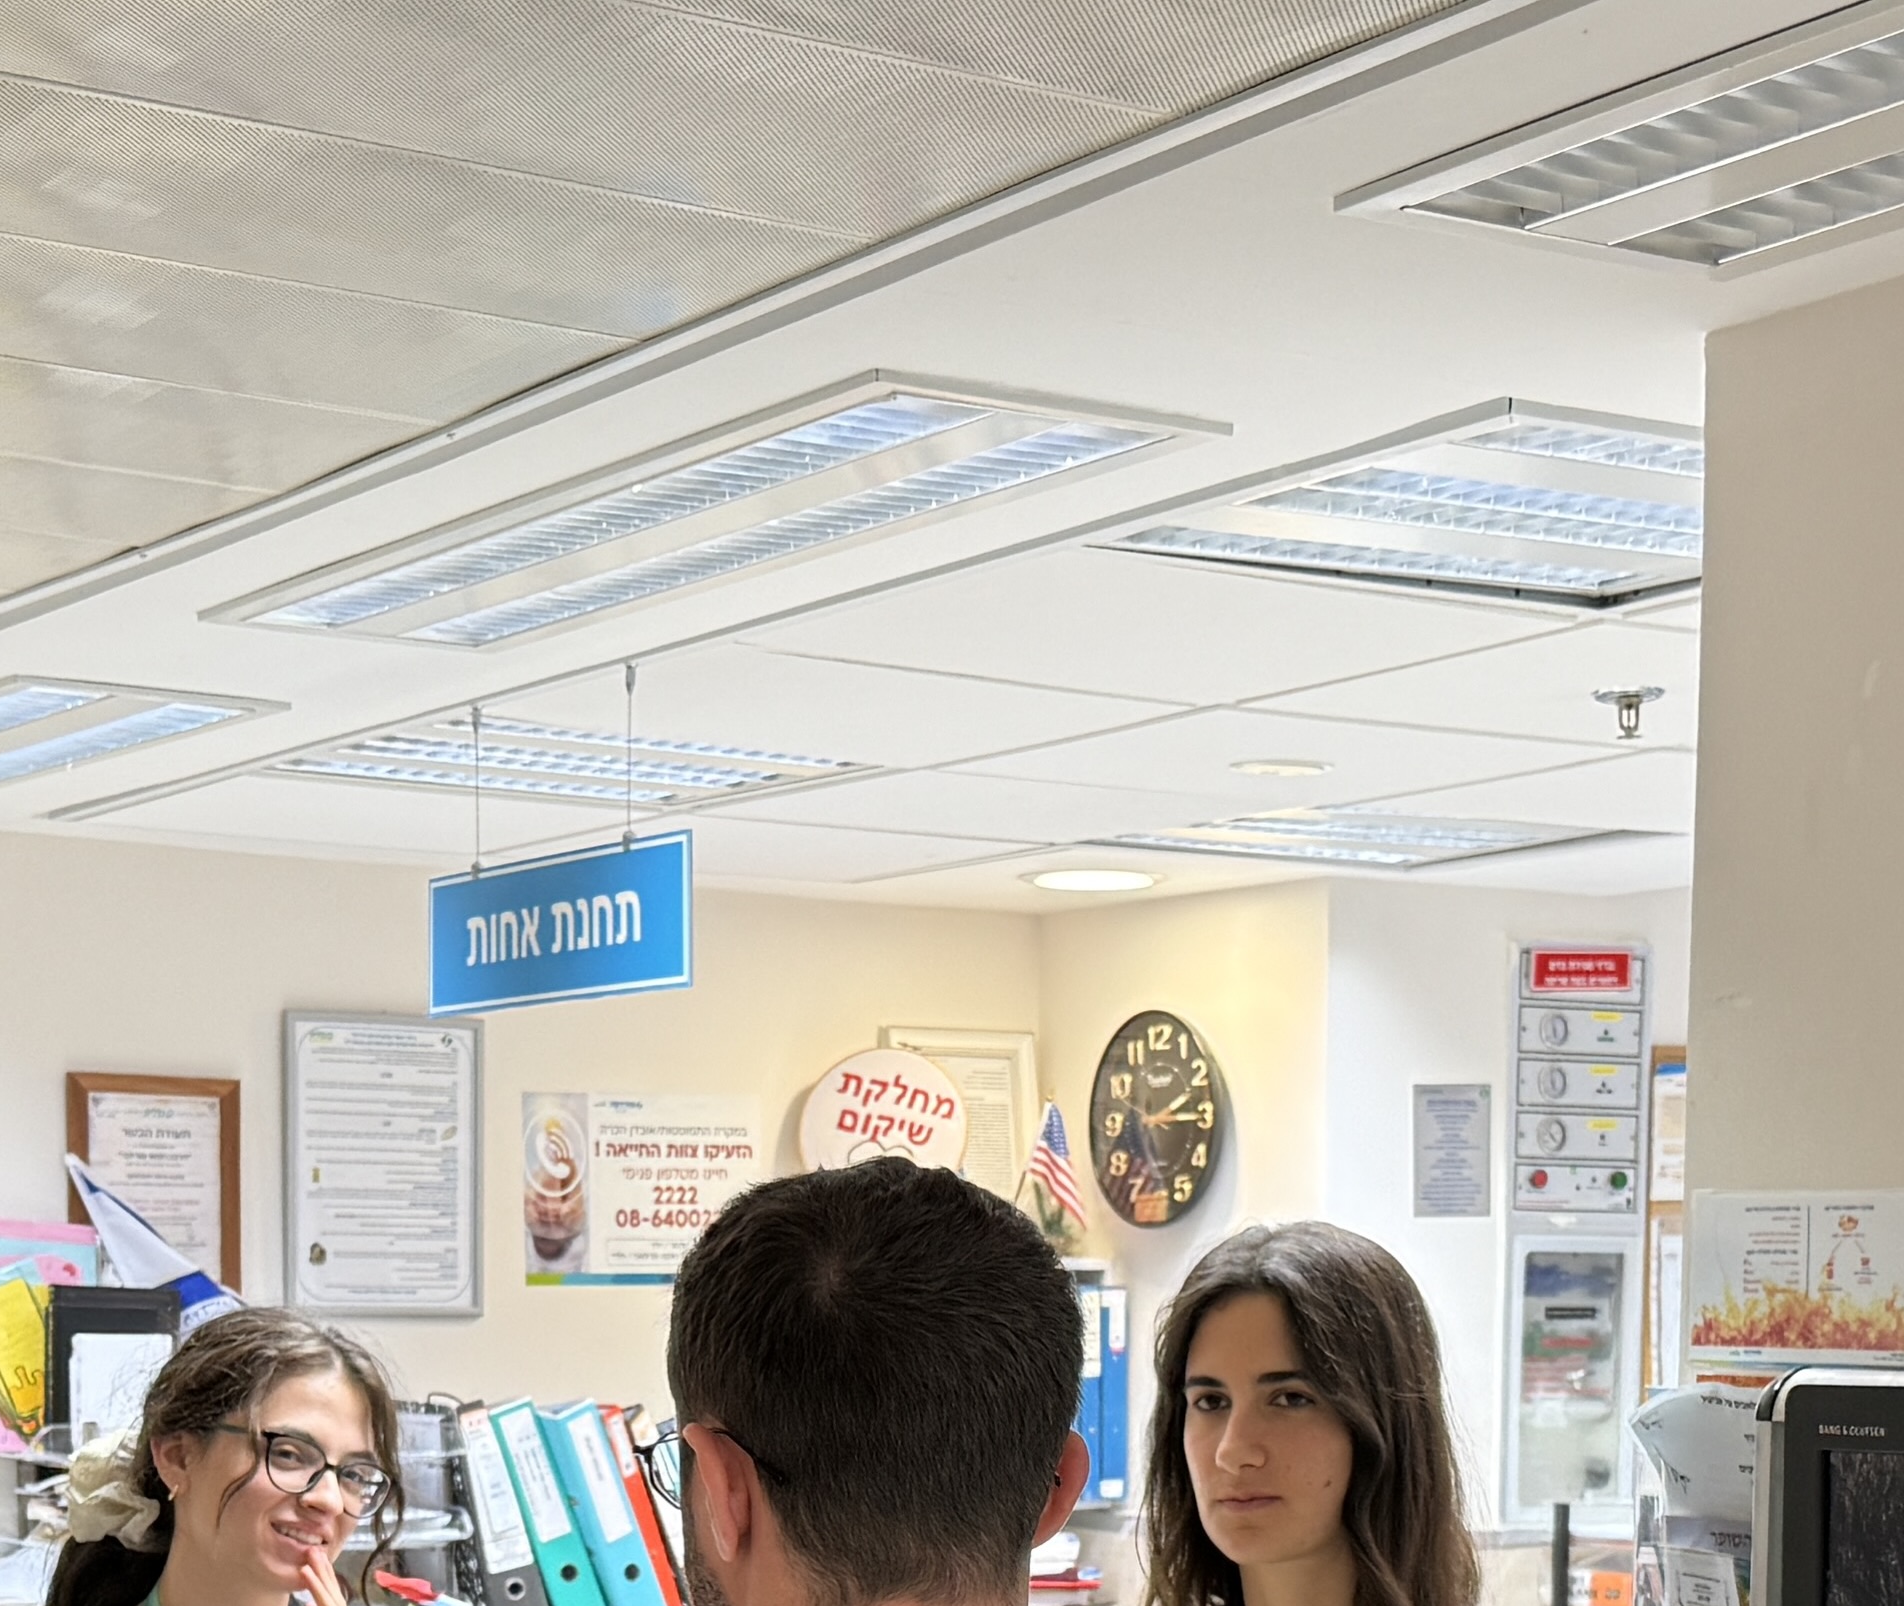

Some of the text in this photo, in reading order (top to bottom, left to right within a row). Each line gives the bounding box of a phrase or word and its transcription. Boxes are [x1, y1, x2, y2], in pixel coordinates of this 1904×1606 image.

[466, 890, 641, 967] תחנת אחות
[1147, 1023, 1174, 1051] 12
[1178, 1032, 1188, 1059] 1
[1127, 1039, 1144, 1066] 11
[1191, 1058, 1208, 1086] 2
[836, 1072, 955, 1120] מחלקת
[1110, 1073, 1133, 1099] 10
[836, 1108, 934, 1146] שיקום
[1105, 1112, 1124, 1137] 9
[1197, 1101, 1214, 1129] 3
[666, 1143, 699, 1159] צוות
[703, 1145, 753, 1161] הזעיקו
[1110, 1152, 1129, 1176] 8
[1191, 1143, 1207, 1169] 4
[652, 1186, 698, 1205] 2222
[1128, 1177, 1145, 1203] 7
[1173, 1174, 1193, 1202] 5
[1818, 1424, 1841, 1436] BANG
